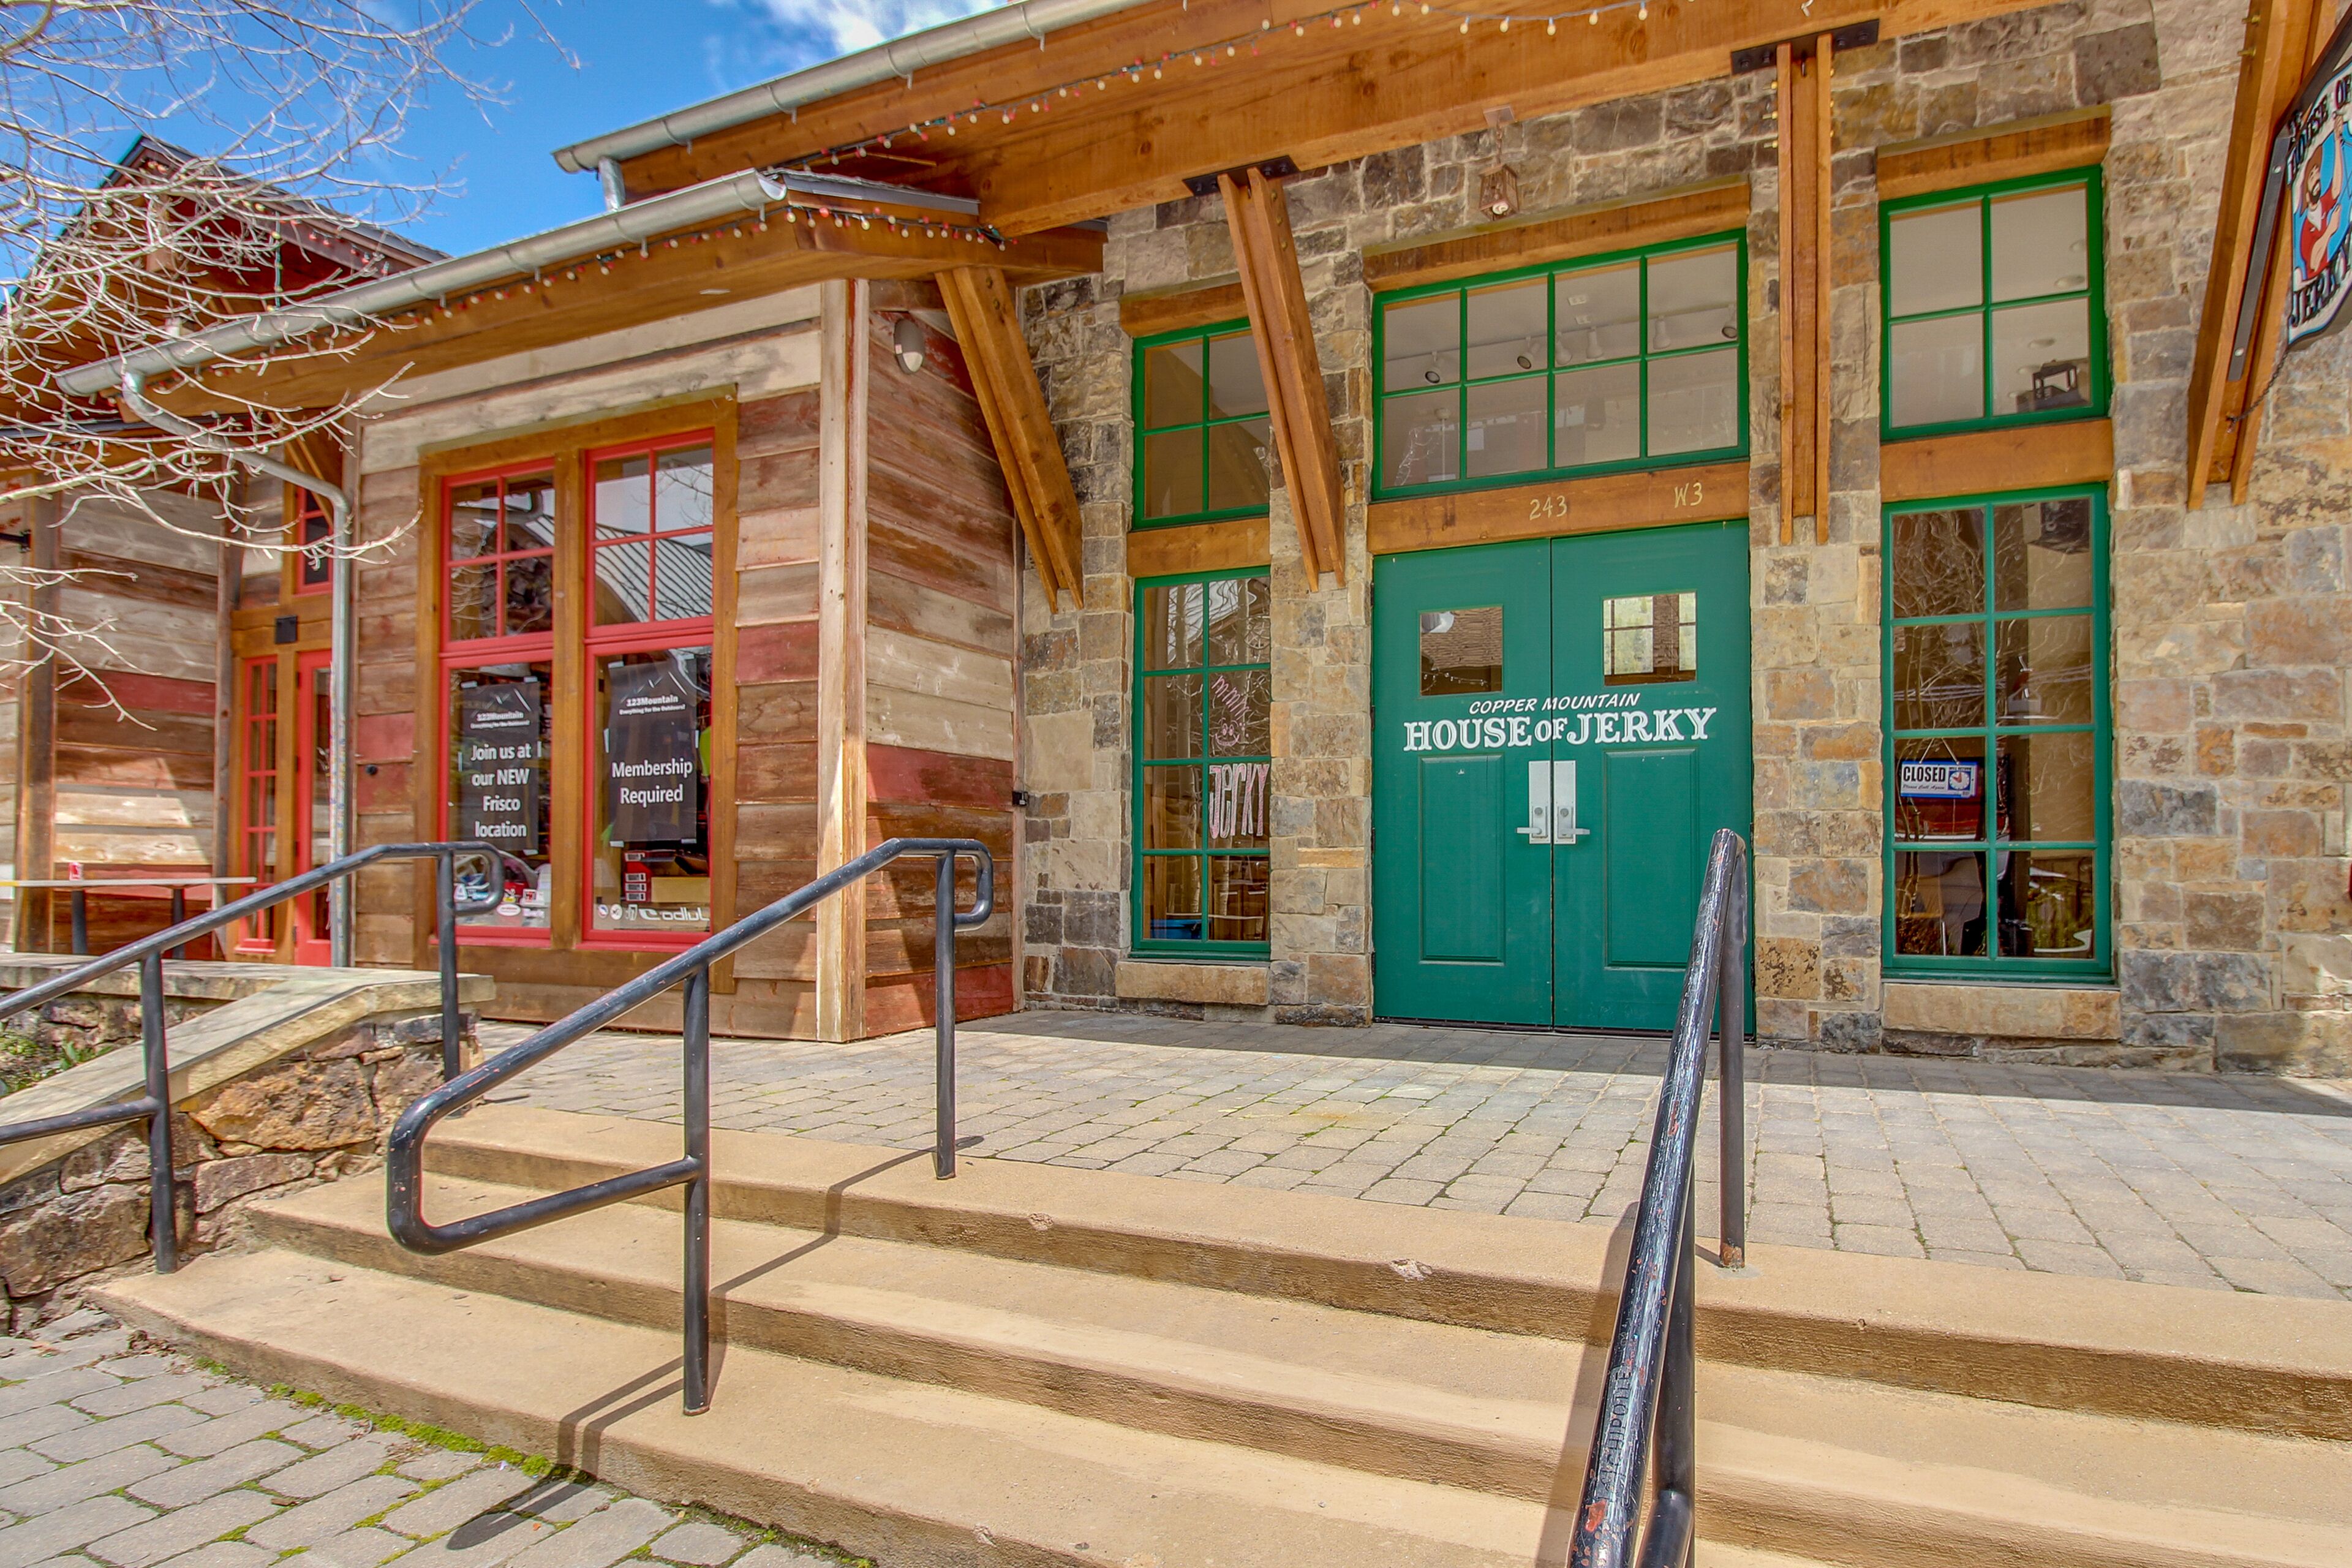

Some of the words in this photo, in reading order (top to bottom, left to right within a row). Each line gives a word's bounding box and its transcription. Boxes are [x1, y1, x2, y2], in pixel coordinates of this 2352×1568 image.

[1529, 494, 1568, 521] 243
[625, 695, 679, 707] 123Mountain
[1469, 698, 1537, 715] COPPER
[1542, 692, 1641, 713] MOUNTAIN
[1403, 715, 1534, 752] HOUSE
[1534, 717, 1567, 742] OF
[1567, 707, 1716, 745] JERKY
[470, 743, 497, 761] Join
[499, 746, 515, 759] us
[517, 743, 532, 758] at
[471, 773, 495, 786] our
[497, 768, 530, 785] NEW
[611, 758, 693, 778] Membership
[1903, 766, 1946, 782] CLOSED
[482, 794, 521, 812] Frisco
[620, 783, 684, 808] Required
[475, 820, 527, 838] location
